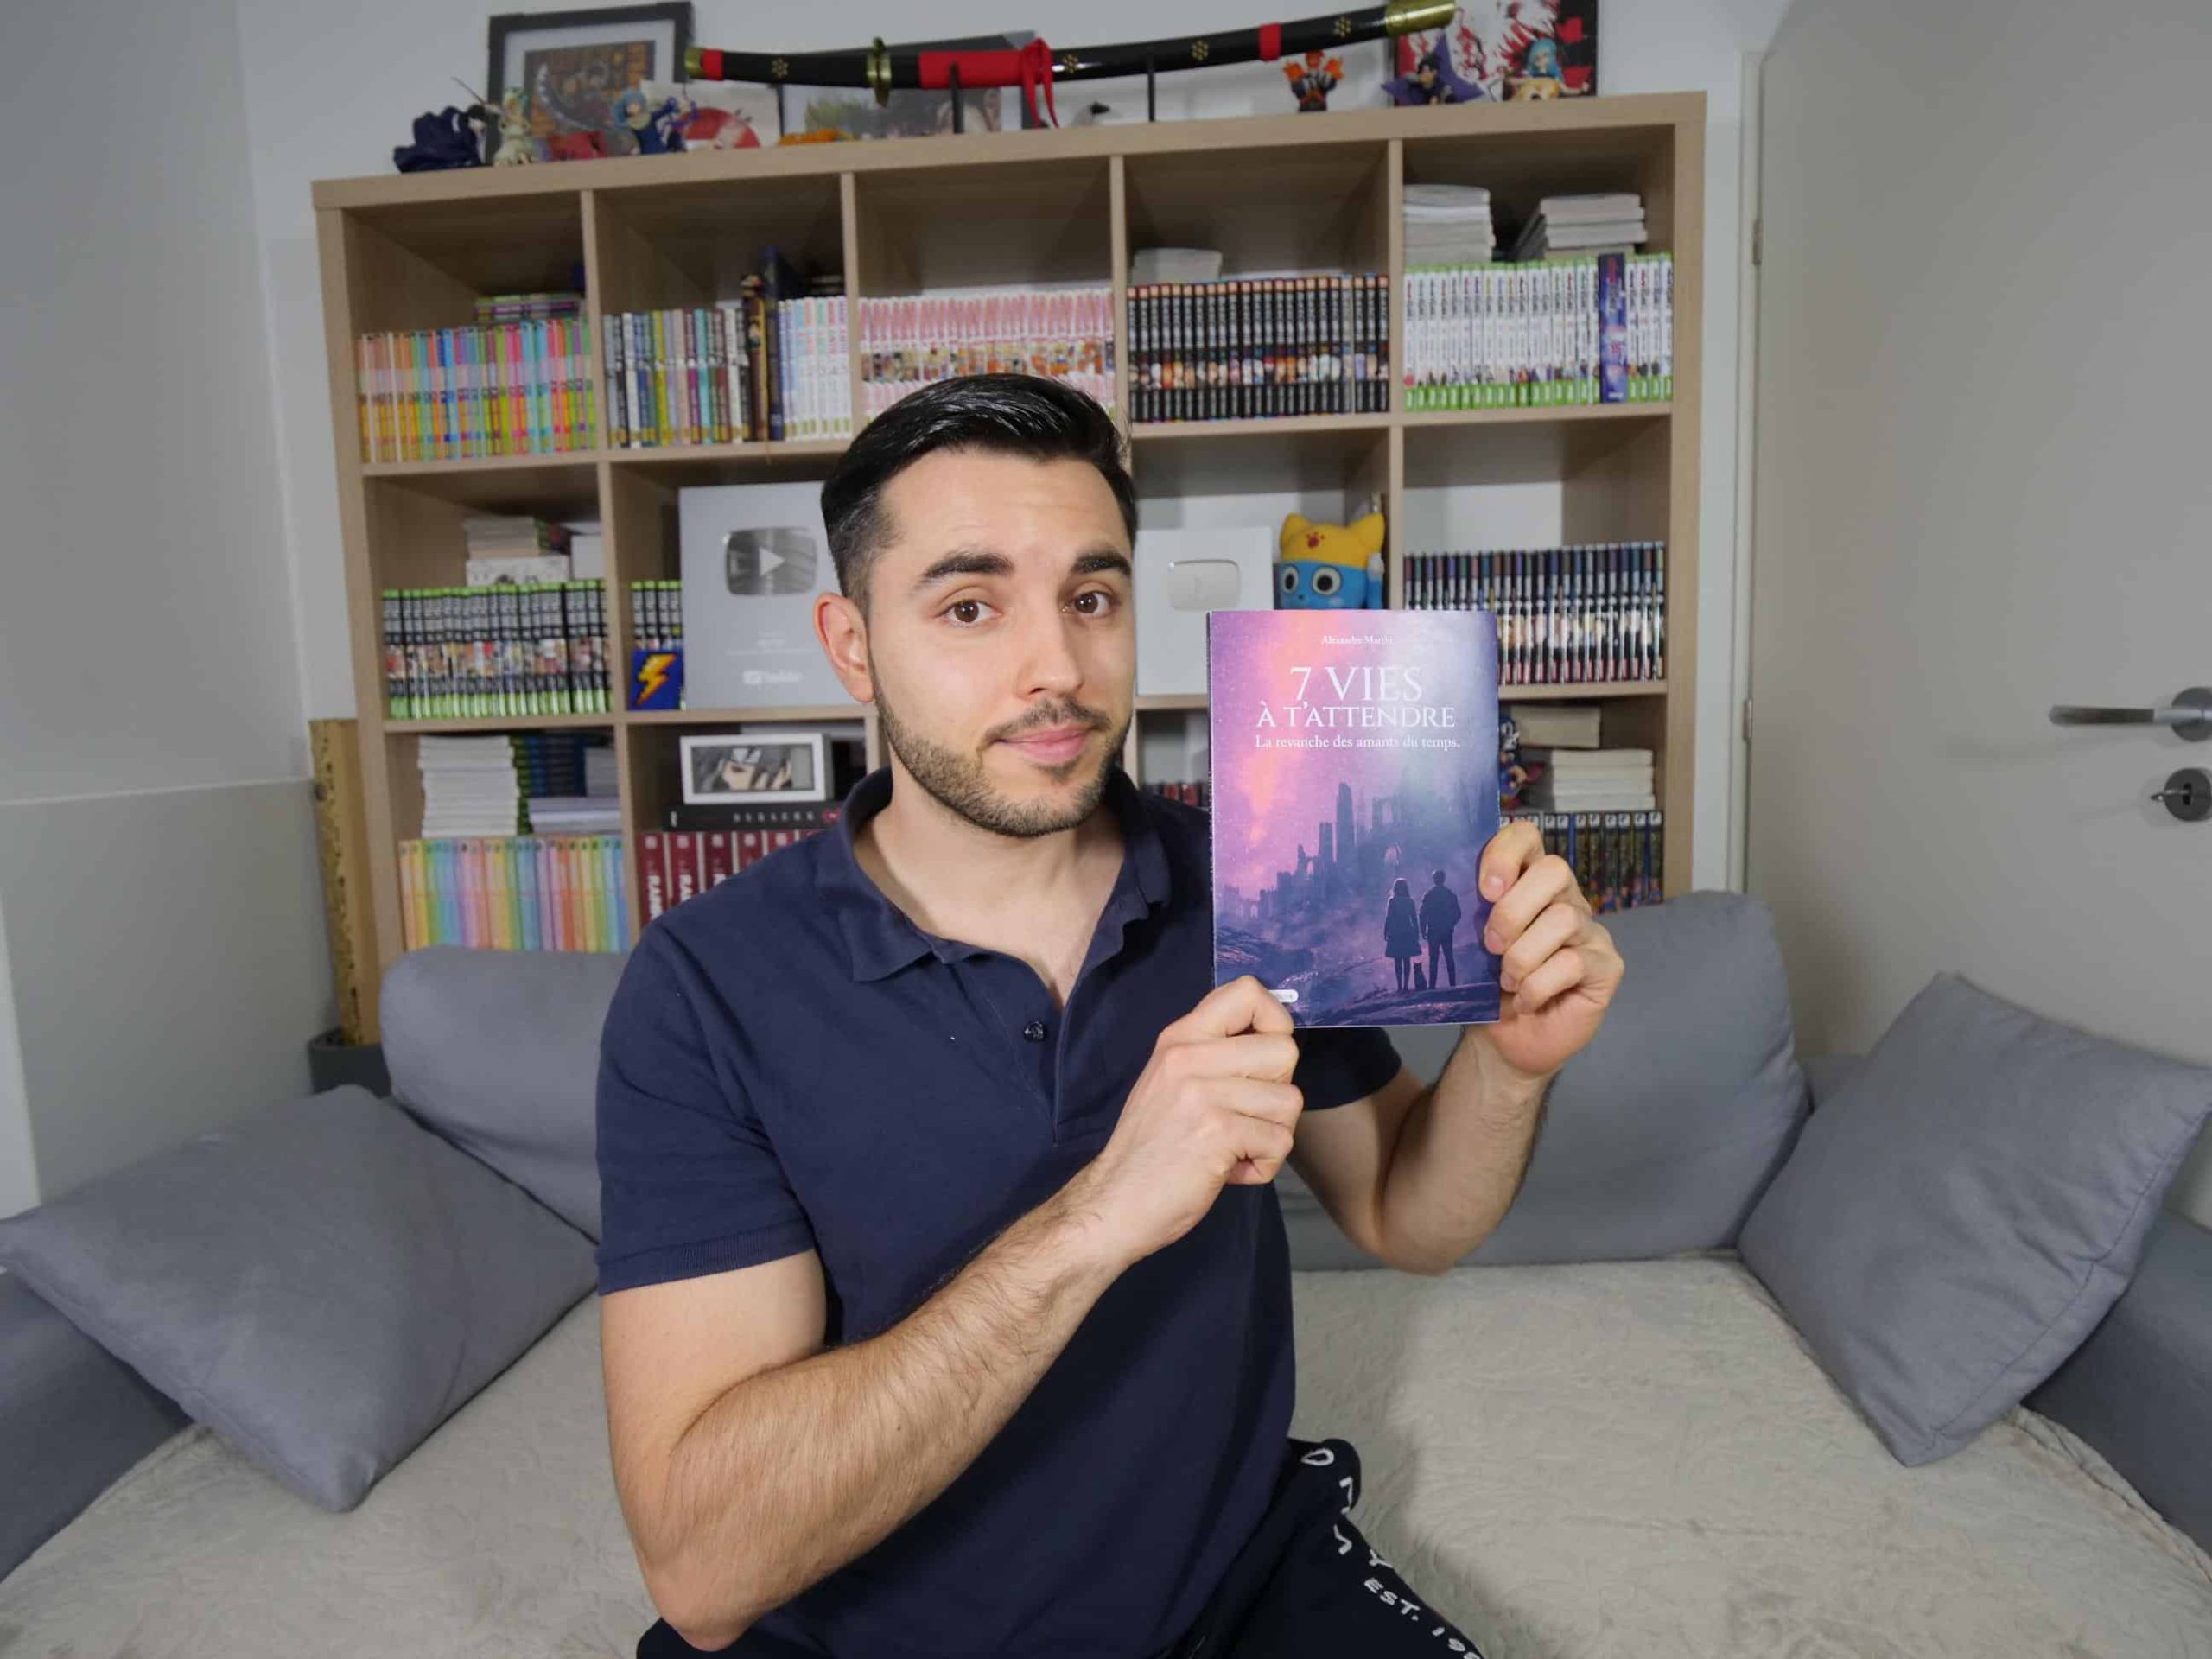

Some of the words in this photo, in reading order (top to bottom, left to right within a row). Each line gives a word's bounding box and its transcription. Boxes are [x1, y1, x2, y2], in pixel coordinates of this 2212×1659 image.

[1289, 666, 1312, 701] 7
[1324, 666, 1422, 702] VIES
[1256, 700, 1277, 728] À
[1282, 701, 1456, 728] T'ATTENDRE
[1255, 734, 1272, 747] La
[1275, 734, 1330, 748] revanche
[1332, 734, 1353, 748] des
[1402, 734, 1419, 748] du
[1421, 737, 1461, 753] temps.
[1363, 1576, 1421, 1623] EST.
